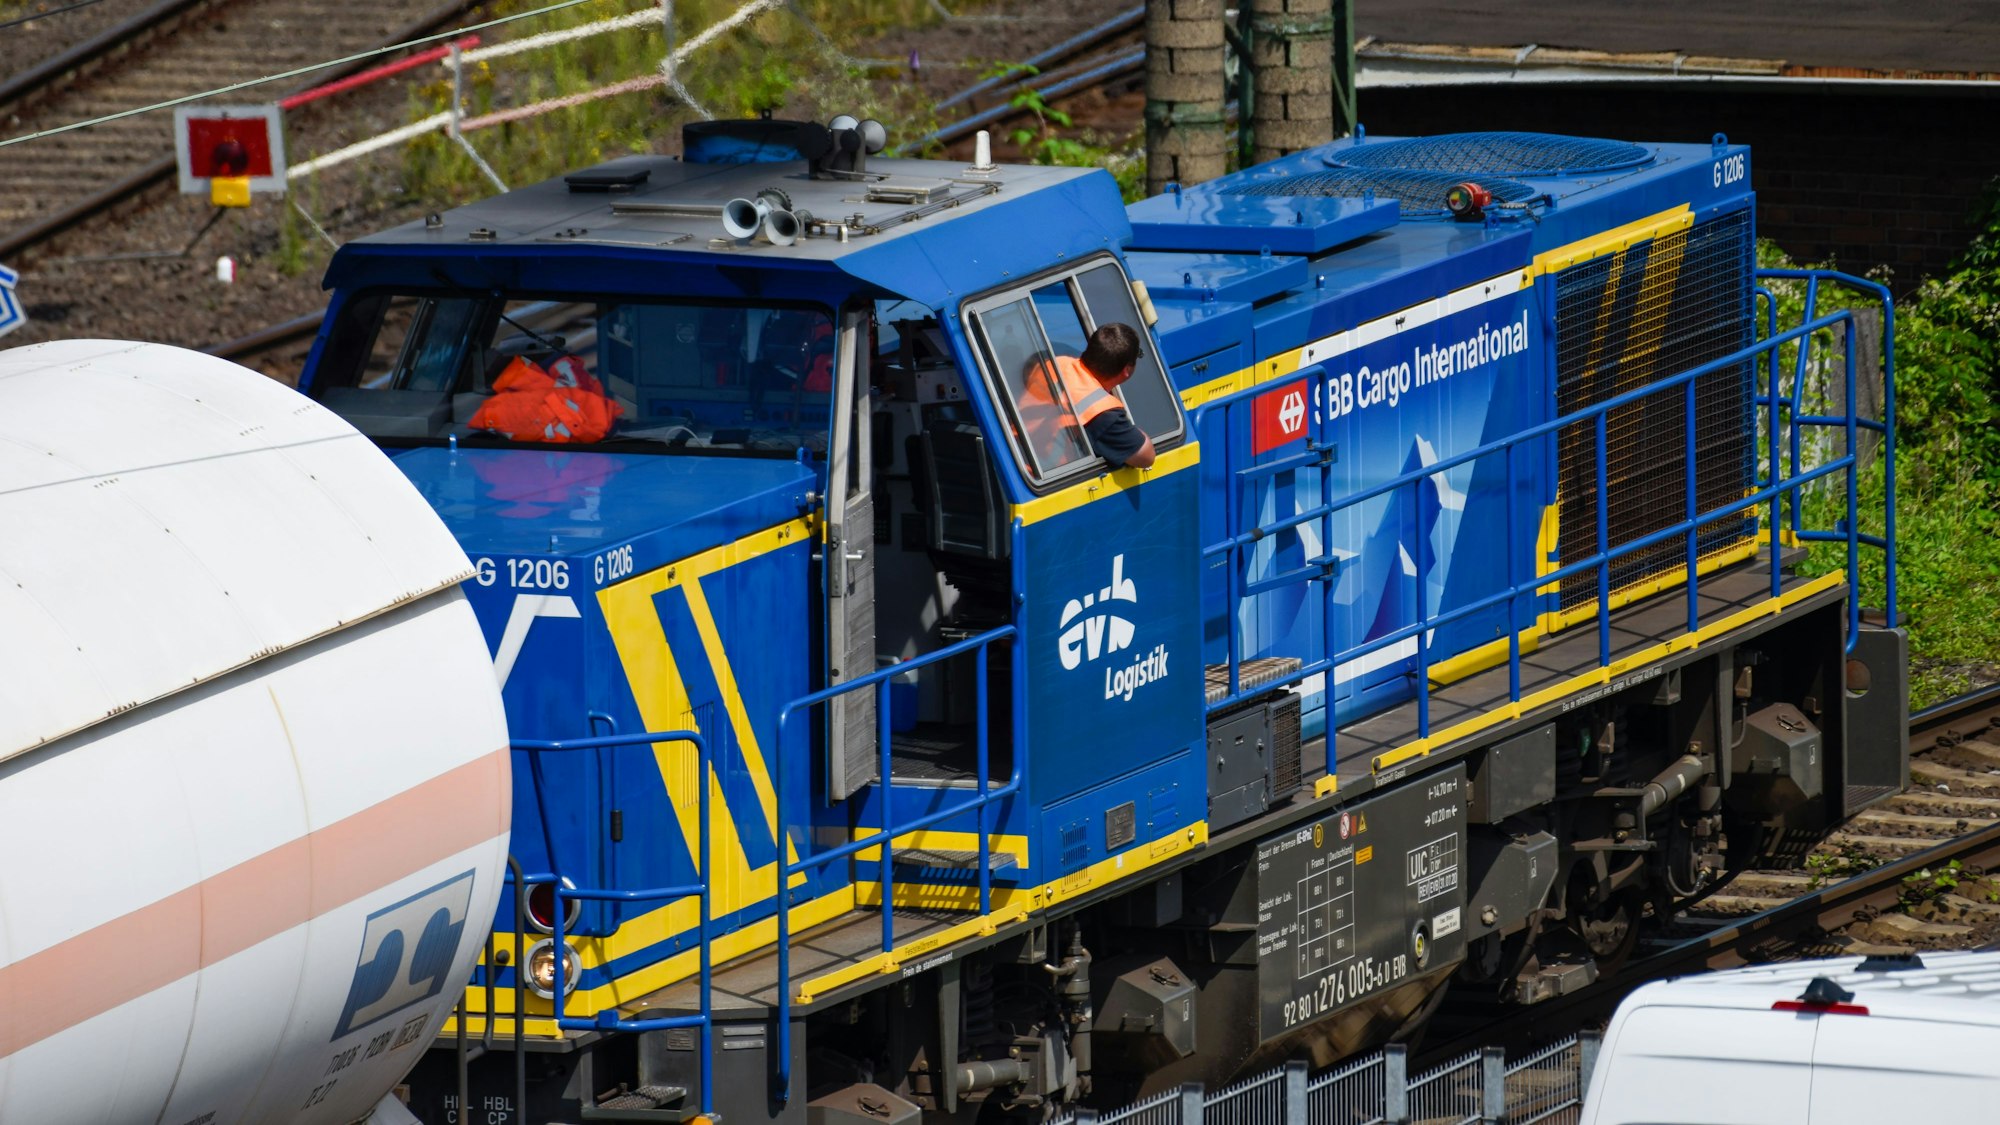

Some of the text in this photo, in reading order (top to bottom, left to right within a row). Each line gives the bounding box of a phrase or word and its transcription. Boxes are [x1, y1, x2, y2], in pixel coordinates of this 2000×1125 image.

[1713, 153, 1744, 188] G 1206
[1357, 362, 1410, 408] Cargo
[1415, 309, 1528, 388] International
[475, 557, 569, 589] G 1206
[594, 544, 633, 585] G 1206
[1105, 643, 1169, 702] Logistik
[1410, 850, 1428, 880] UIC
[1284, 1000, 1296, 1027] 92
[1298, 994, 1311, 1021] 80
[1384, 960, 1390, 983] D
[1393, 954, 1406, 980] EVB
[484, 1096, 514, 1111] HBL
[488, 1111, 507, 1125] CP
